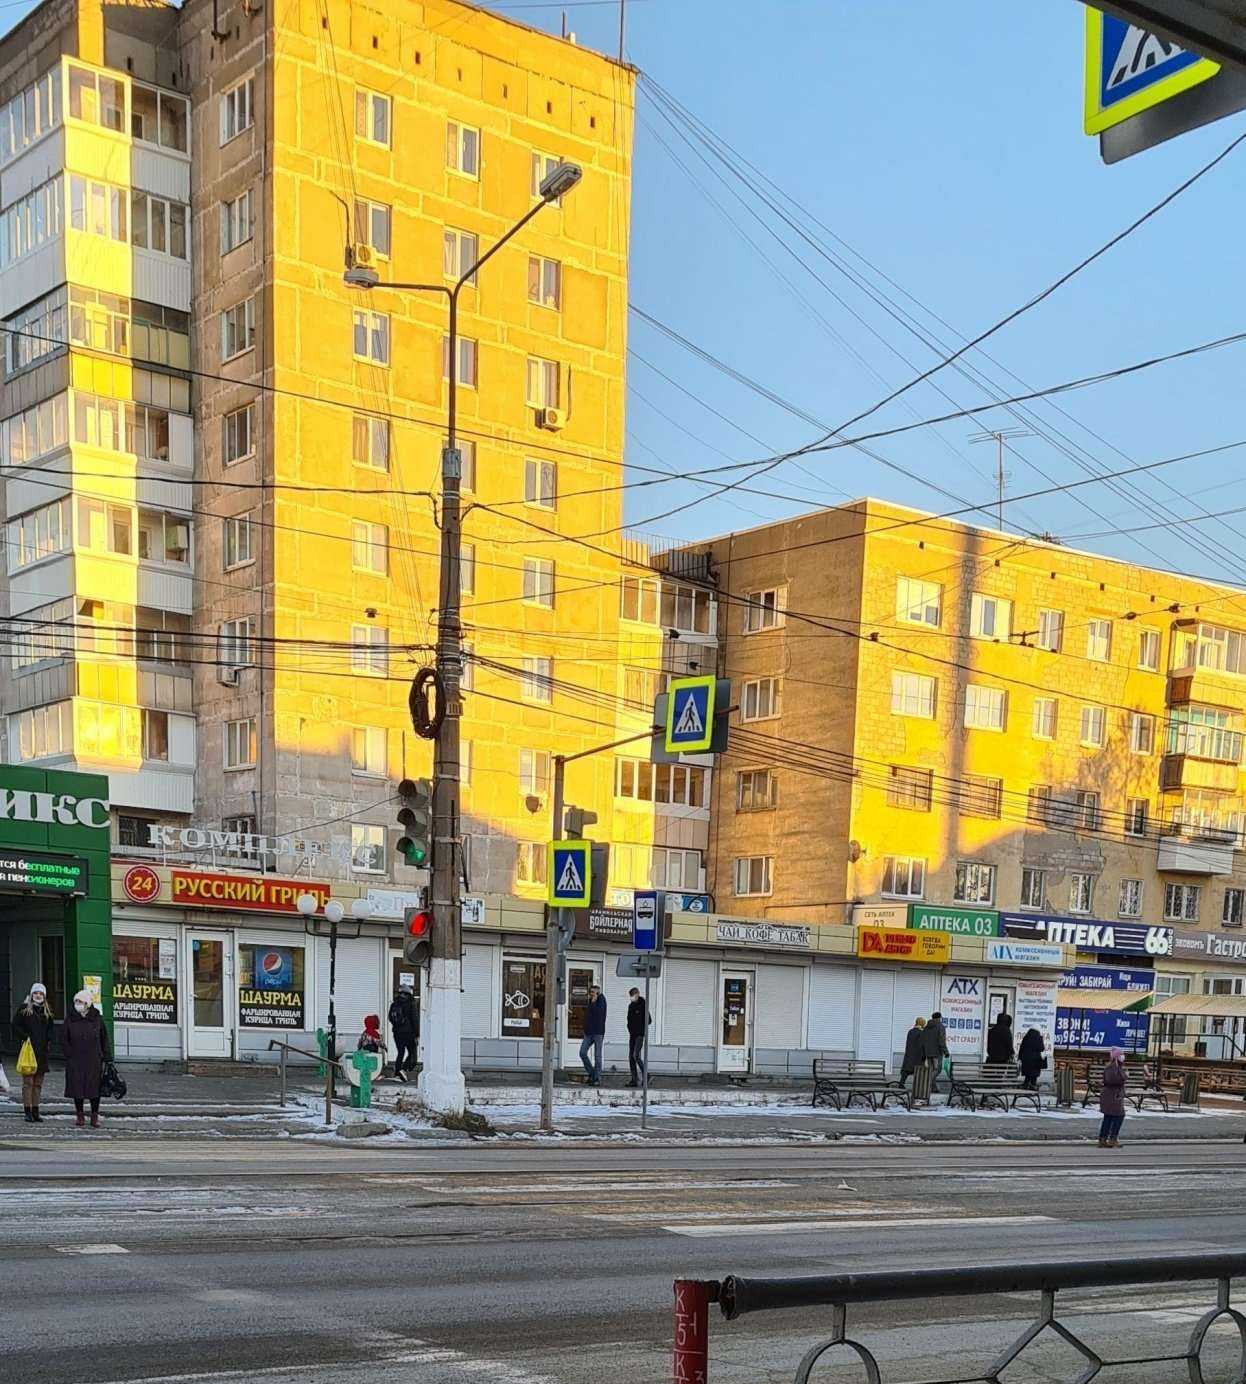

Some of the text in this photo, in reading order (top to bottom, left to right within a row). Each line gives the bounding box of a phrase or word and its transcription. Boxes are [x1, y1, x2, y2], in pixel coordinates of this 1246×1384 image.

[18, 860, 80, 876] бесплатные
[8, 873, 75, 888] пенсионеров
[131, 876, 153, 892] 24
[174, 876, 265, 902] РУССКИЙ
[589, 914, 633, 933] БОЙЛЕРНАЯ
[919, 915, 993, 936] АПТЕКА 03
[745, 928, 773, 941] КОФЕ
[778, 931, 808, 944] ТАБАК
[1145, 927, 1171, 955] 66
[1079, 975, 1112, 988] ЗАБИРАЙ
[240, 990, 302, 1006] ШАУРМА
[113, 1002, 174, 1013] АРШИРОВАННАЯ
[146, 1012, 170, 1020] ГРИЛЬ
[245, 1016, 298, 1025] КУРИЦА ГРИЛЬ
